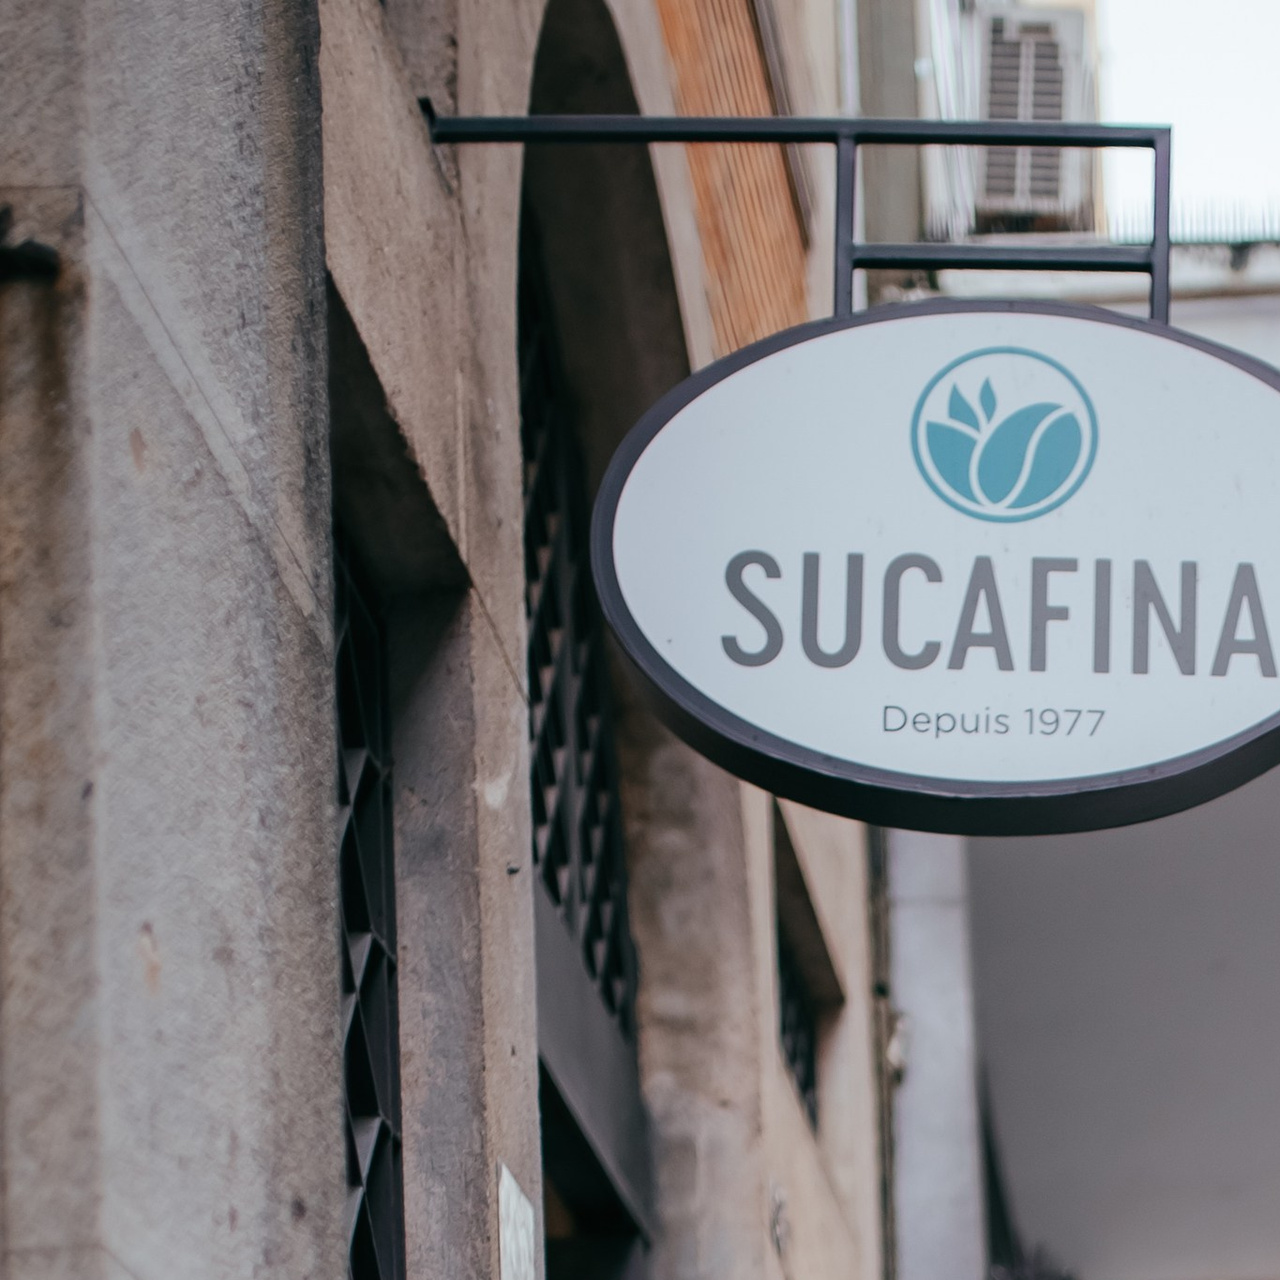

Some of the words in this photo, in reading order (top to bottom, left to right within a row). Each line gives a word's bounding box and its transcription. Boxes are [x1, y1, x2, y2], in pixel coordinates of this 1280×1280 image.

[720, 549, 1278, 678] SUCAFINA
[882, 705, 1010, 738] Depuis
[1024, 708, 1105, 736] 1977
